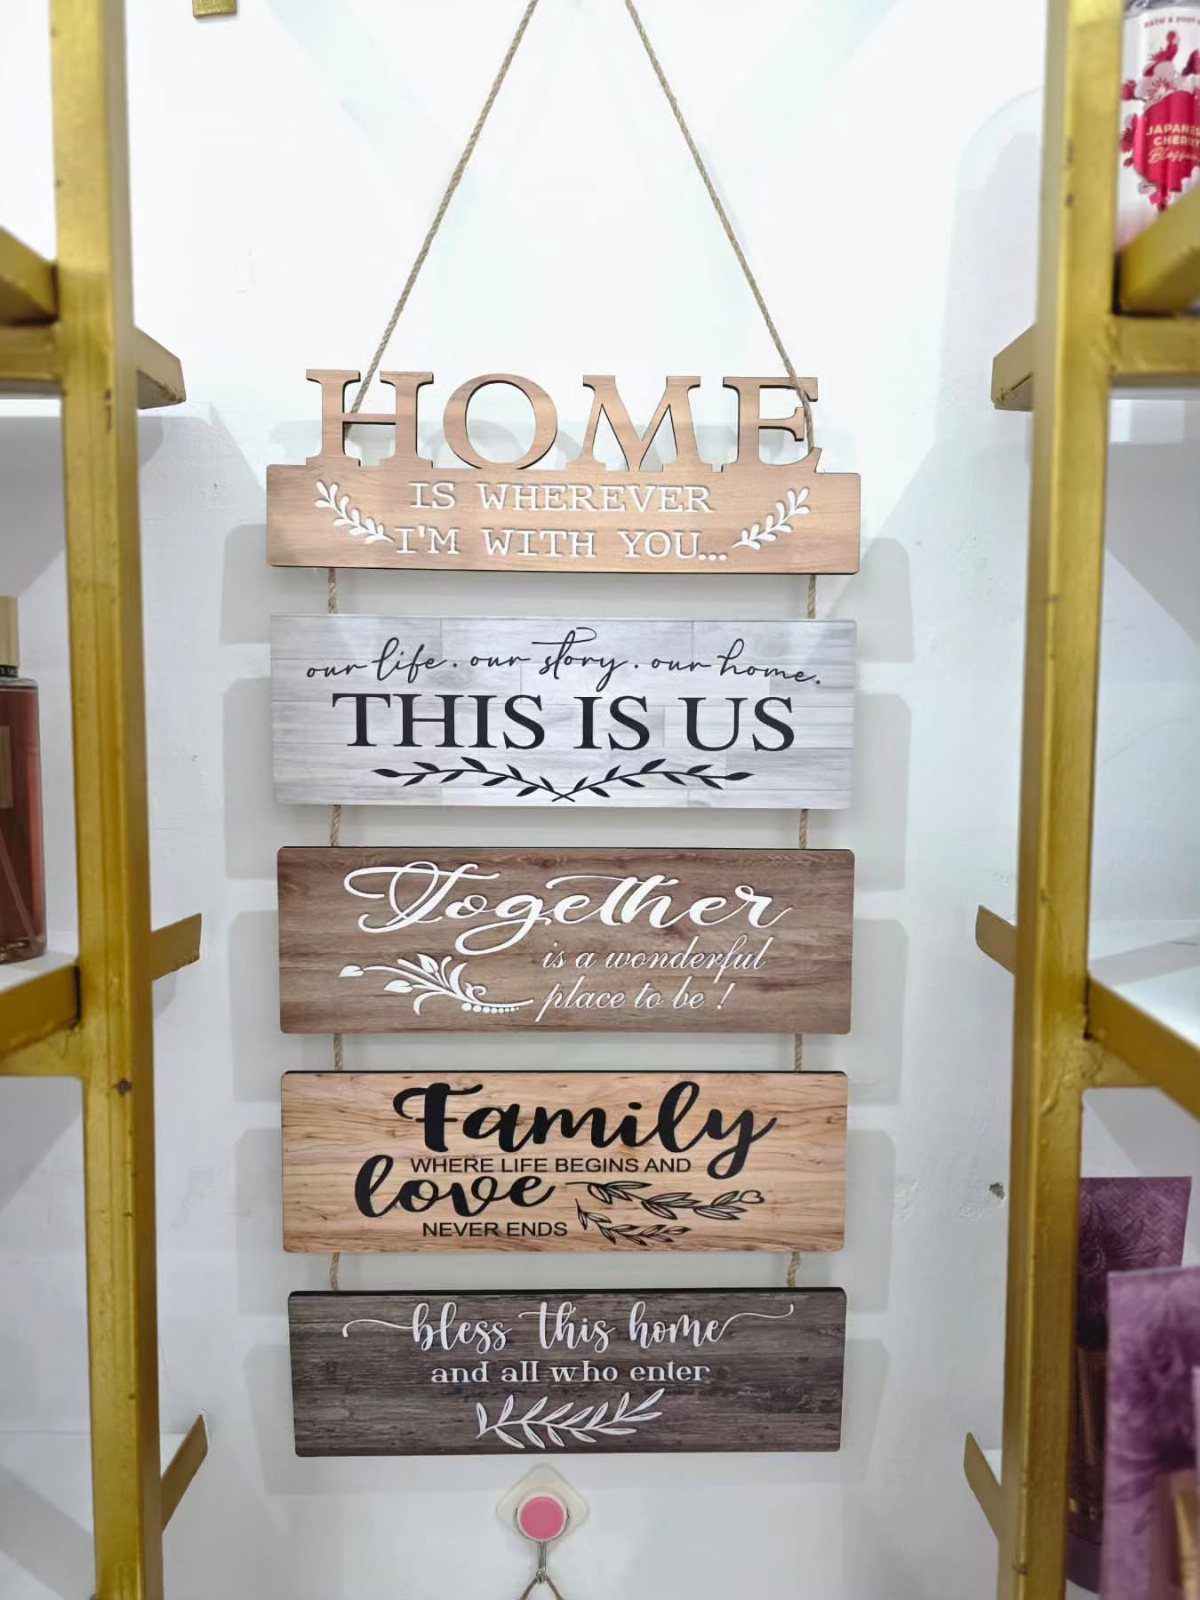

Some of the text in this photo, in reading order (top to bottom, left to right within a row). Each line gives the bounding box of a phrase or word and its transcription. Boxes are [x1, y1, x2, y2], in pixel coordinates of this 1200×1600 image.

[306, 369, 821, 473] HOME
[409, 482, 712, 514] IS WHEREVER
[394, 528, 728, 562] I'M WITH YOU...
[306, 662, 366, 679] our
[469, 654, 530, 667] our
[651, 656, 713, 669] our
[715, 639, 823, 686] home.
[331, 693, 795, 752] THIS IS US
[343, 861, 793, 956] Together
[542, 936, 768, 984] is a wonderful
[534, 976, 626, 1022] place
[634, 982, 665, 1009] to
[673, 975, 706, 1009] be
[393, 1080, 778, 1180] Family
[354, 1154, 555, 1219] love
[410, 1157, 692, 1173] WHERE LIFE BEGINS AND
[422, 1221, 568, 1238] NEVER ENDS
[343, 1300, 795, 1354] bless this home
[430, 1360, 711, 1384] and all who enter
